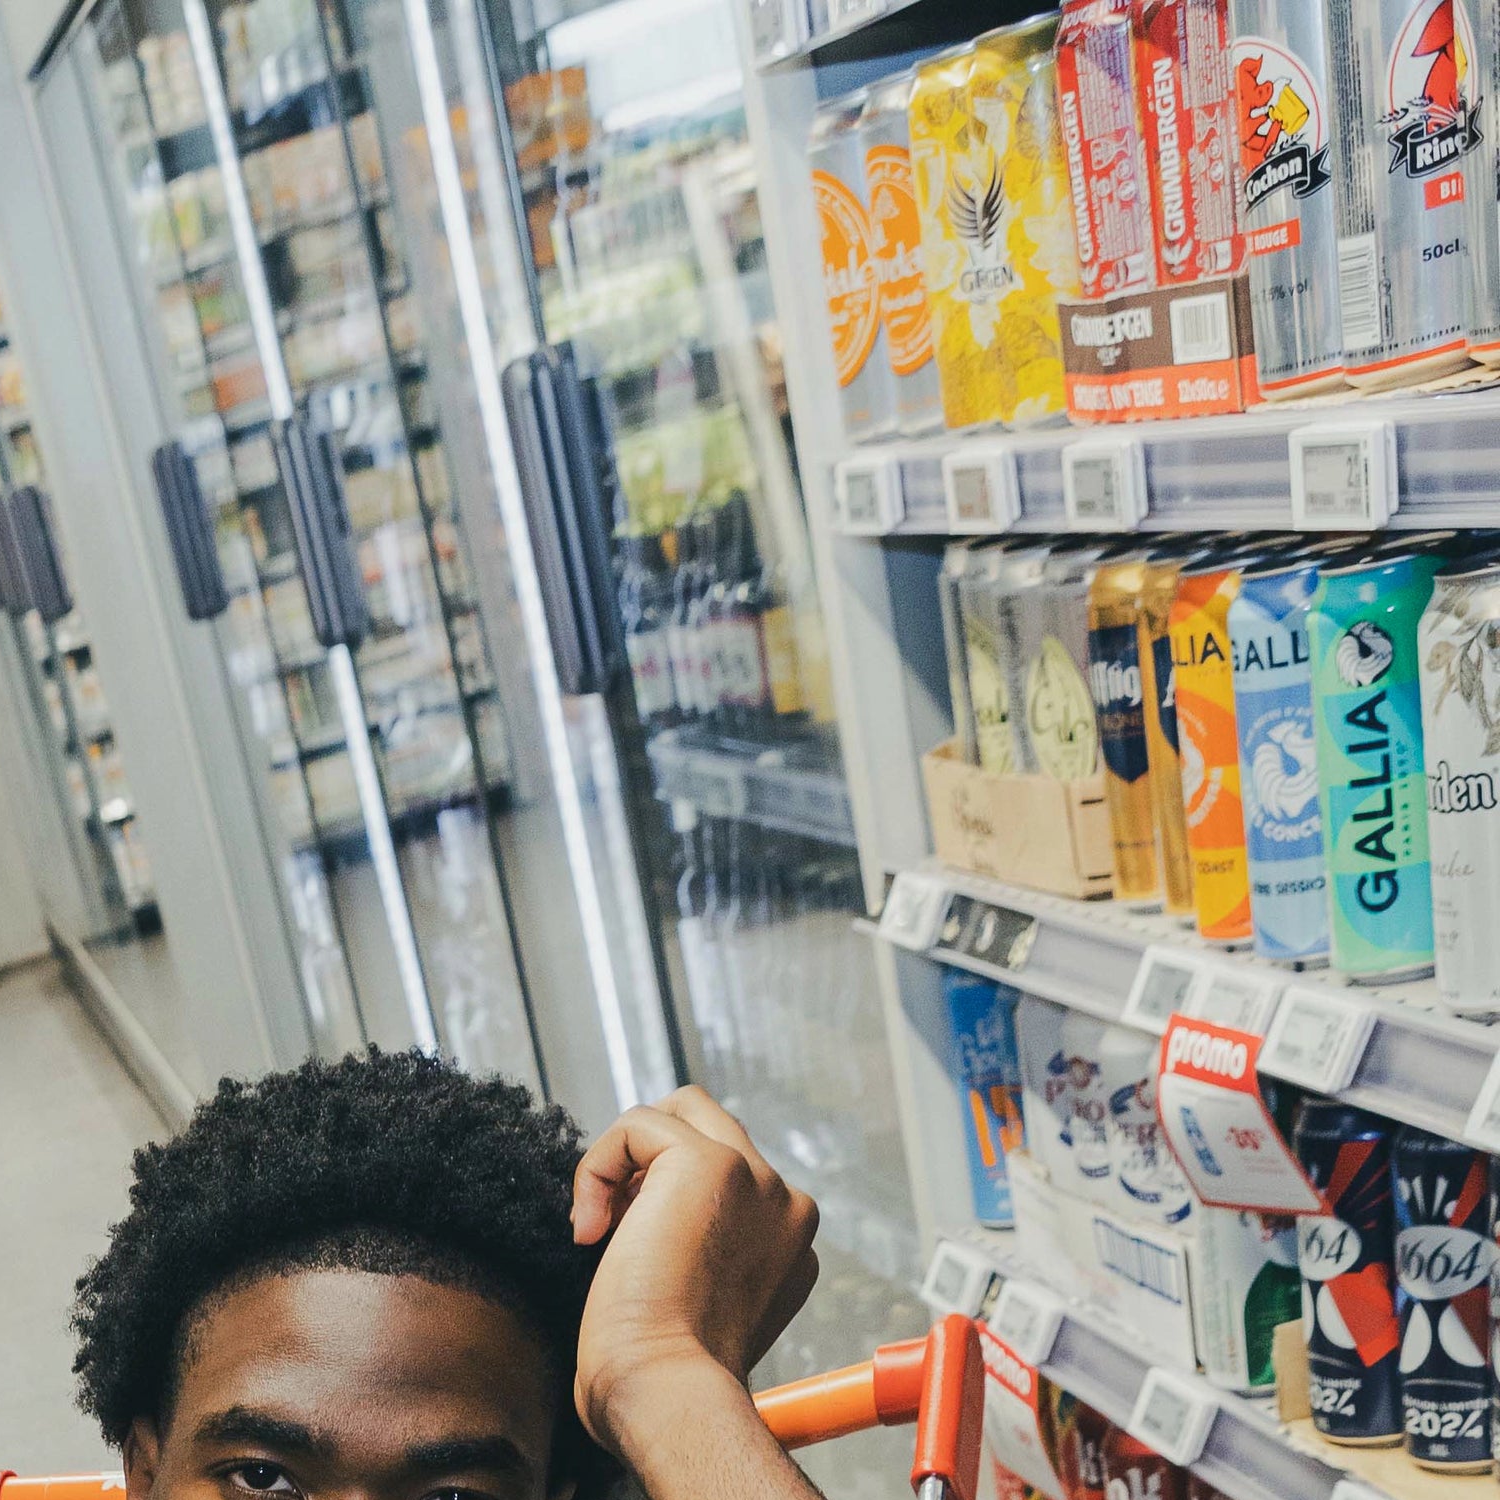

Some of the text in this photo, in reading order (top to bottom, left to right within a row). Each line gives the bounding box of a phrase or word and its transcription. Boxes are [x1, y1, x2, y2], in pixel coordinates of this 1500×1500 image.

[1152, 56, 1186, 241] GRIMBERGEN
[1061, 91, 1095, 263] GRIMBERGEN
[1246, 155, 1303, 203] Cochon
[1422, 238, 1460, 262] 50cl
[1344, 690, 1400, 914] GALLIA
[1165, 1025, 1248, 1080] promo
[1405, 1406, 1484, 1439] 2024
